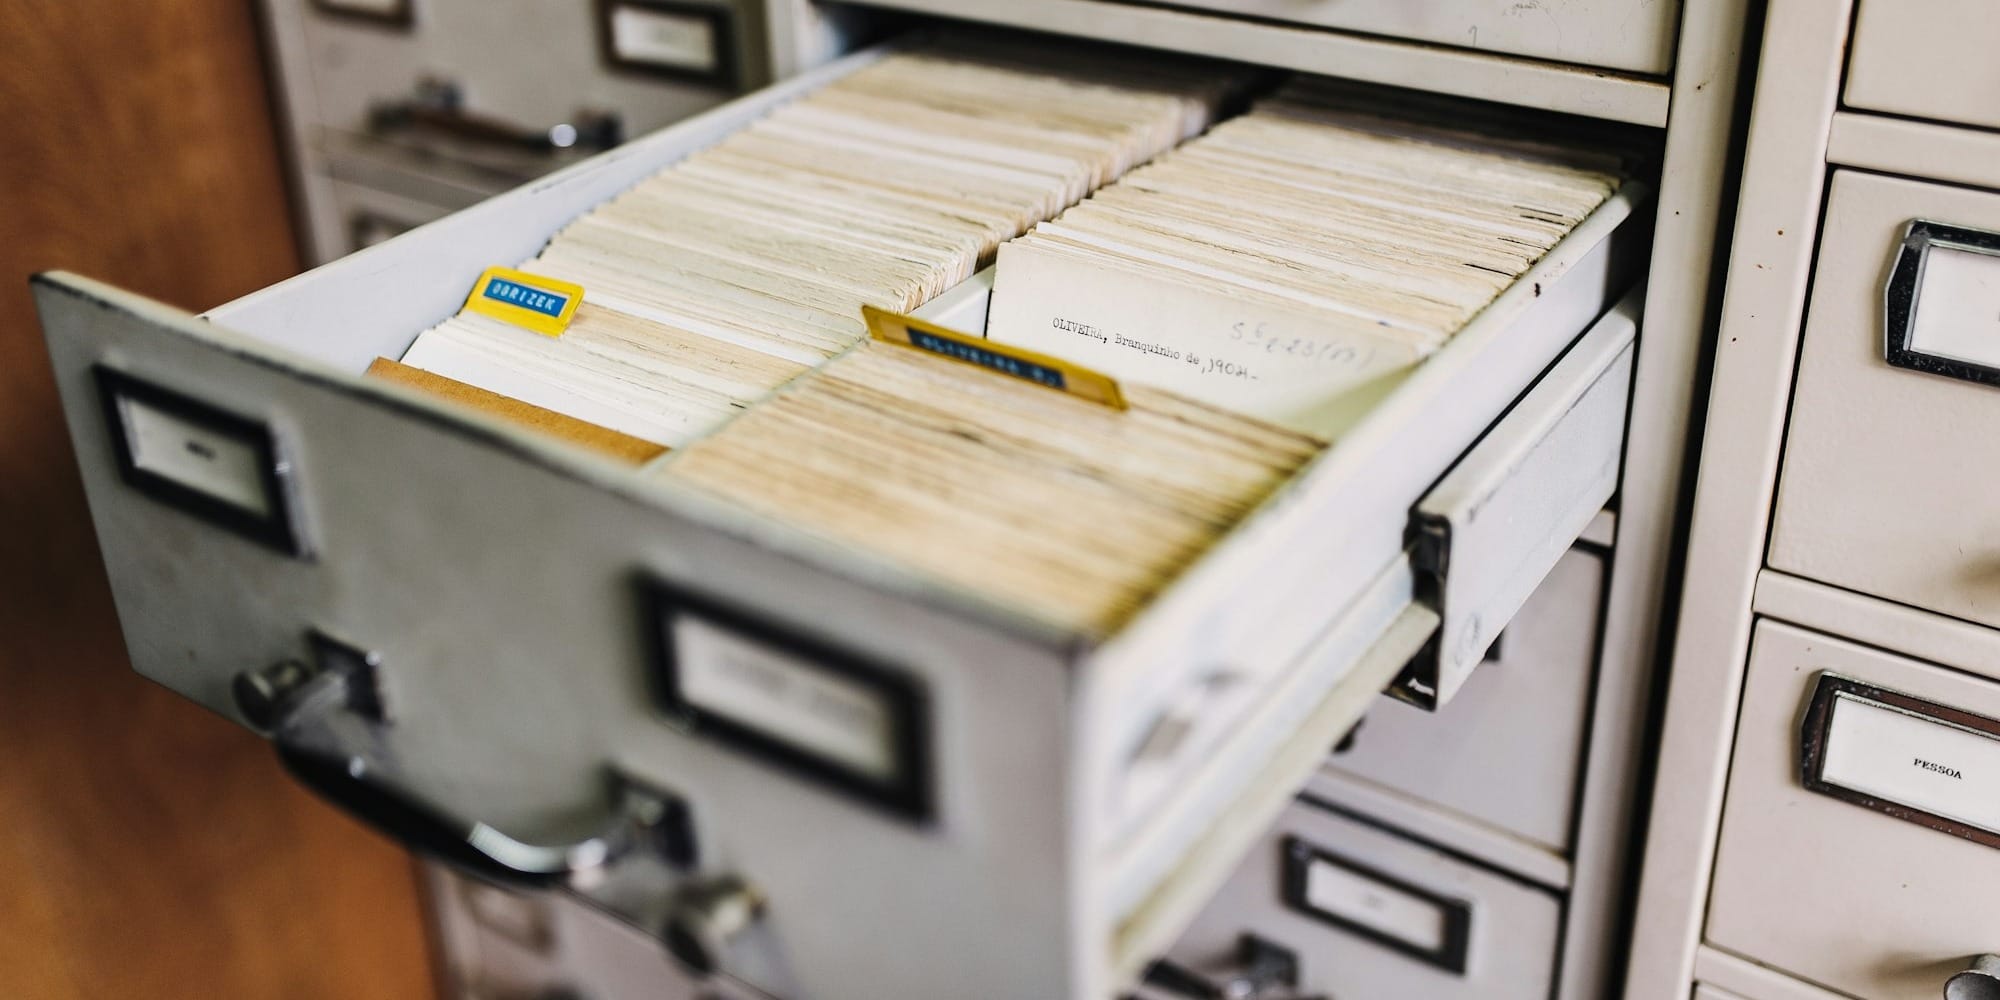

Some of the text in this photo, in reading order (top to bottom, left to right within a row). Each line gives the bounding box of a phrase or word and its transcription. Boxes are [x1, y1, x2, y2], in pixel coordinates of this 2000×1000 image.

[1052, 317, 1108, 344] OLIVEIRA,
[1115, 333, 1180, 360] Branquinho
[1913, 758, 1962, 780] PESSOA
